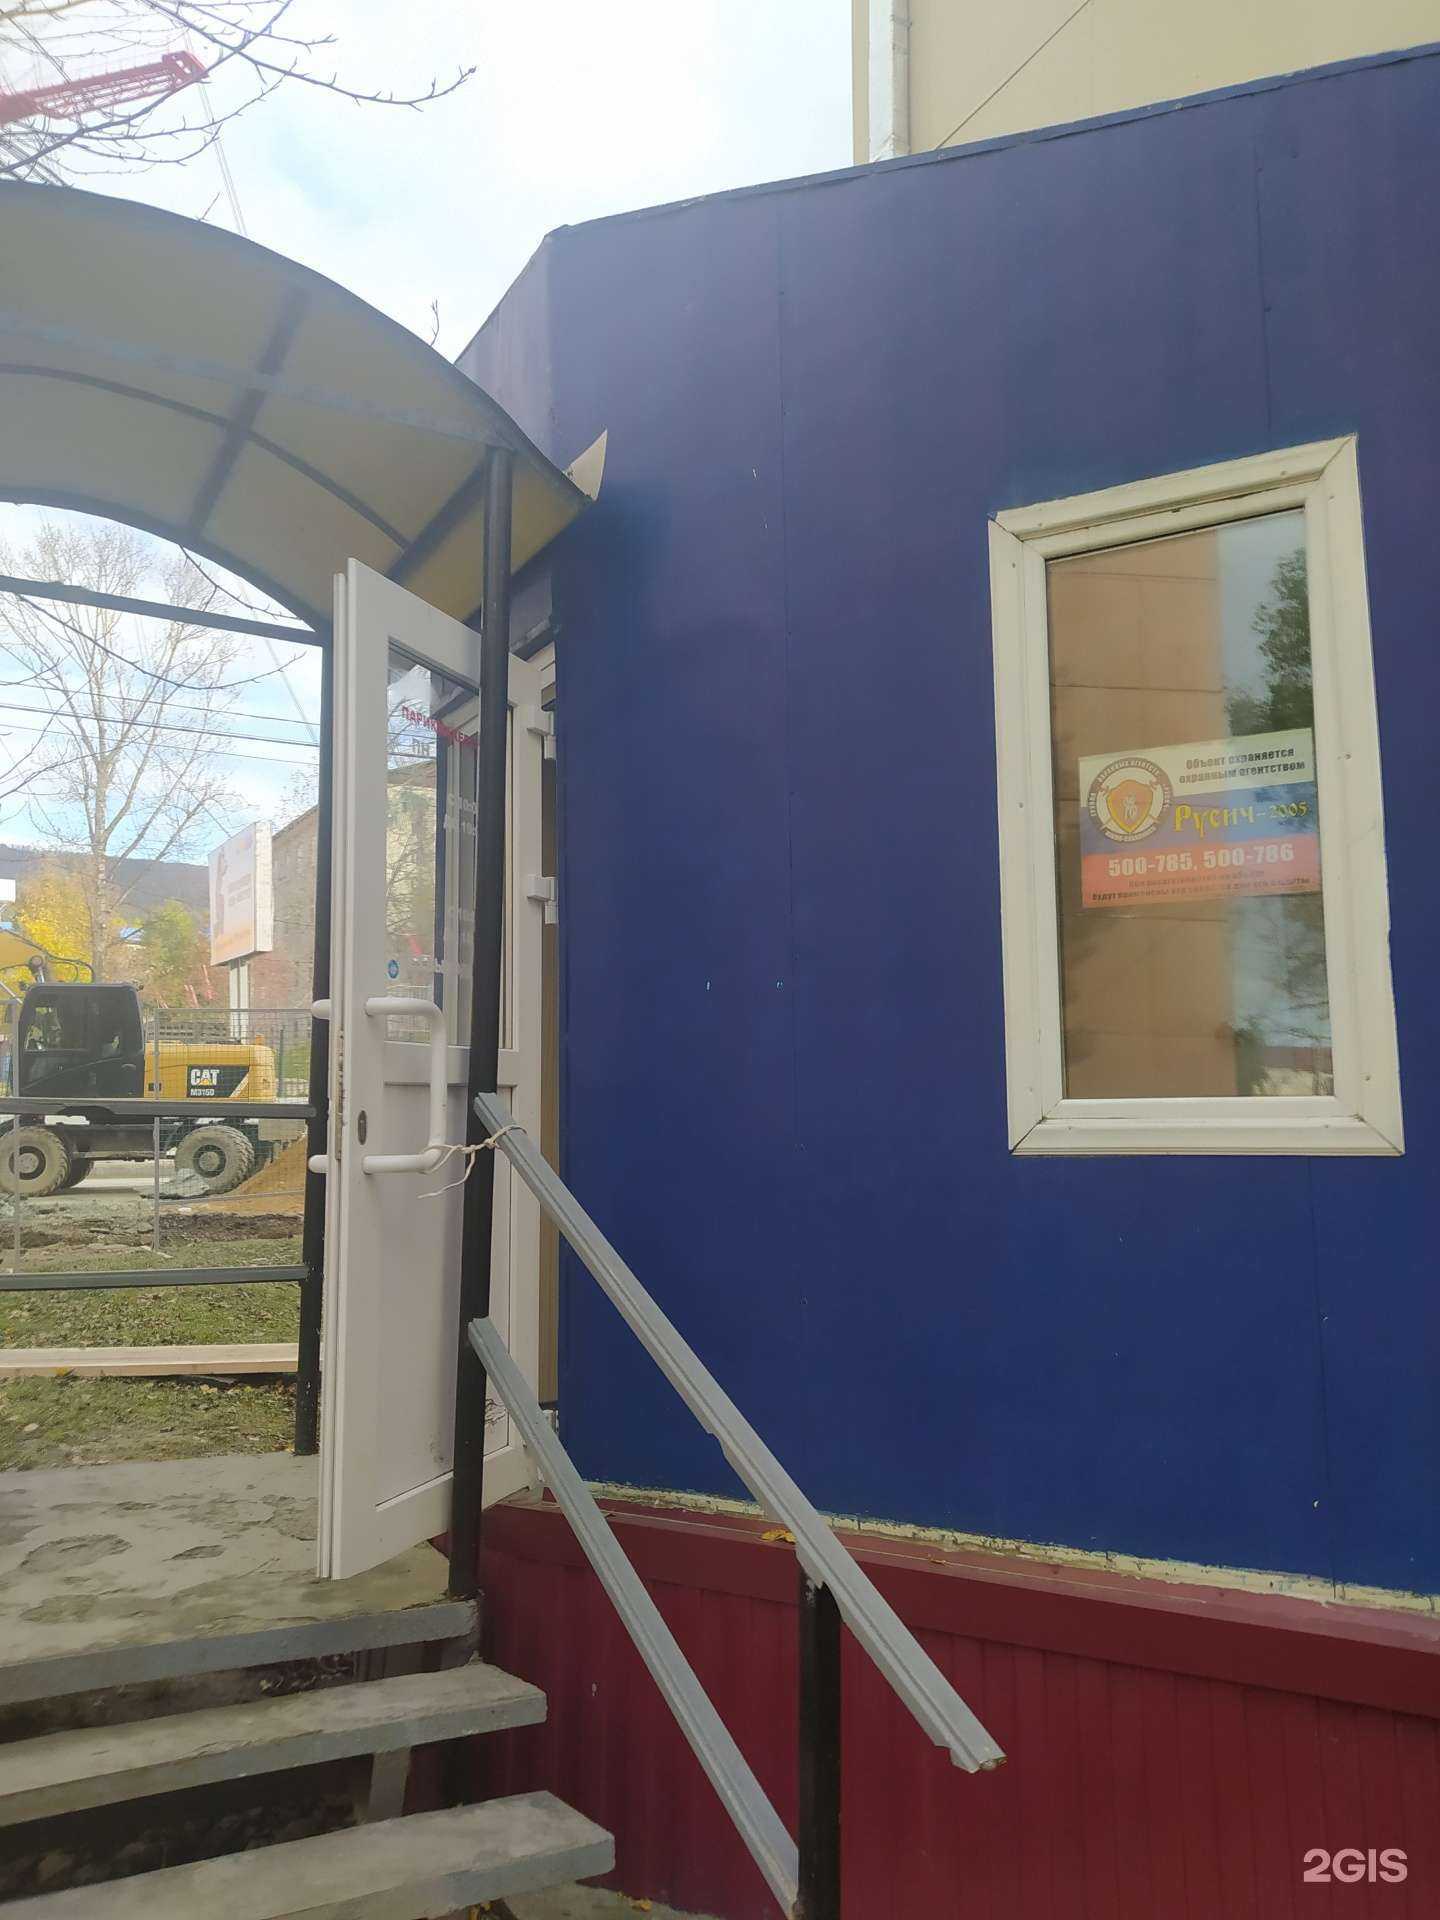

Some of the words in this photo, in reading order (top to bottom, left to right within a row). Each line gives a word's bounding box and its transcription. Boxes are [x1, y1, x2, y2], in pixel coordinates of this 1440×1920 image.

[1228, 748, 1294, 764] охраняется
[1179, 768, 1237, 783] охранным
[1239, 761, 1305, 776] агентством
[190, 1069, 220, 1086] CAT
